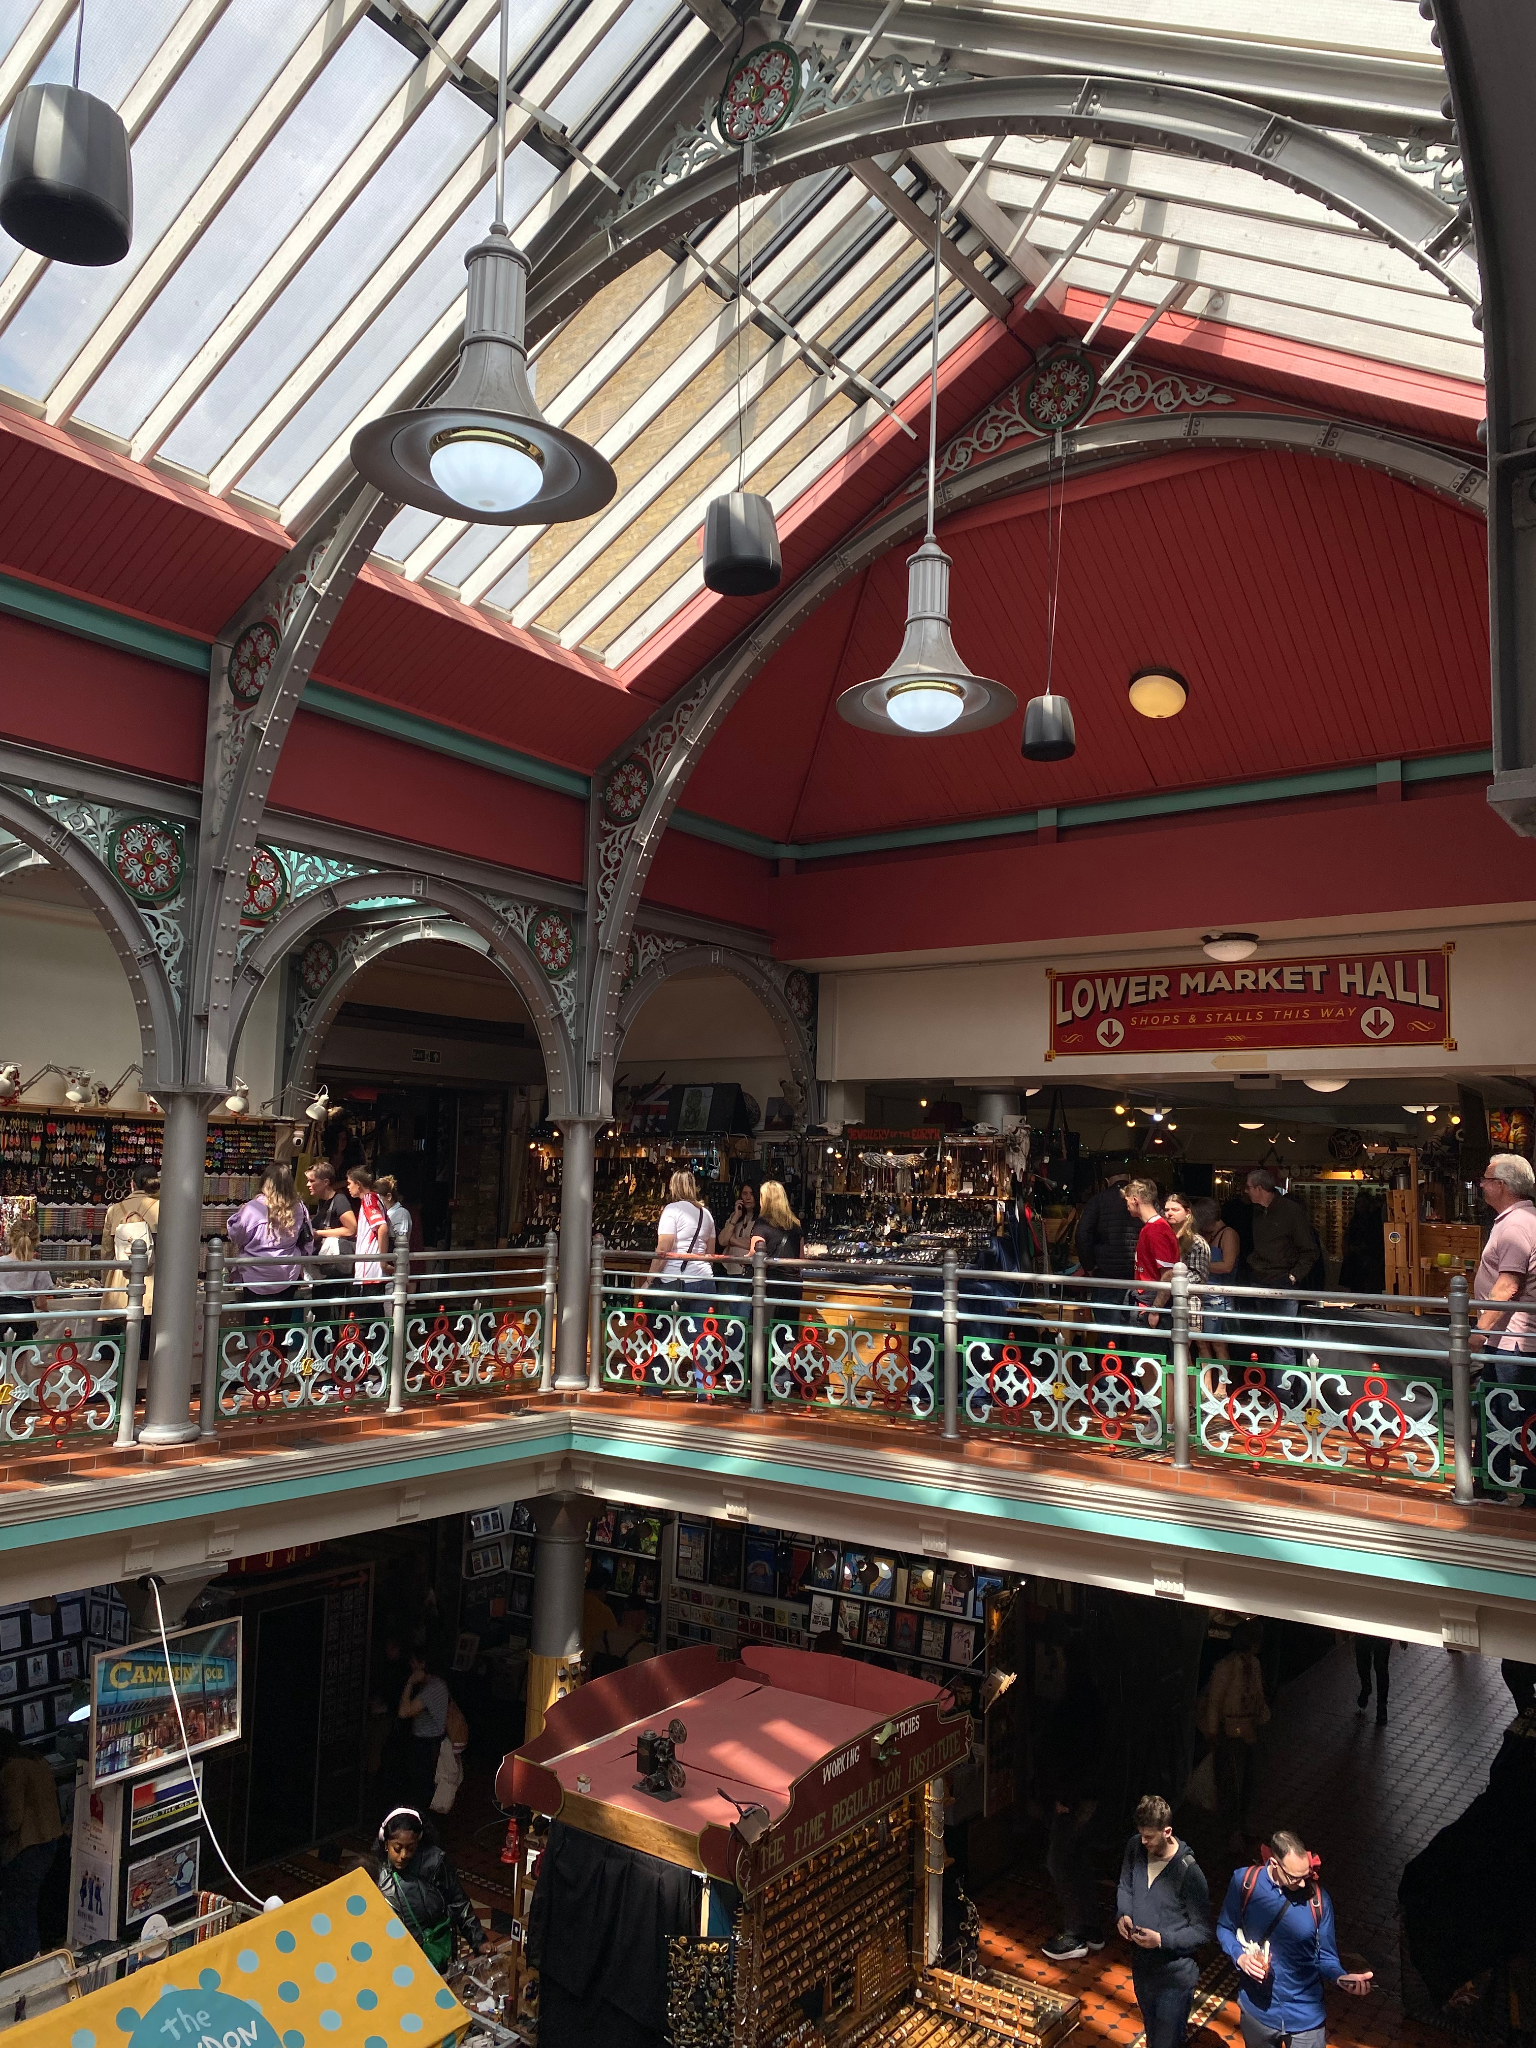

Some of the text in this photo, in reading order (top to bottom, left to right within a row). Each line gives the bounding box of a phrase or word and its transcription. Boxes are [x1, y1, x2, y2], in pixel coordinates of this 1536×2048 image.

[1056, 958, 1441, 1026] LOWER MARKET HALL
[1130, 1006, 1358, 1026] SHOPS & STALLS THIS WAY
[109, 1661, 193, 1690] CAMDEN
[822, 1714, 920, 1785] WORKING TCHES
[137, 1812, 158, 1824] MIND
[161, 1804, 179, 1814] THE
[760, 1729, 961, 1875] THE TIME REGULATION INSTITUTE
[159, 2007, 212, 2040] the
